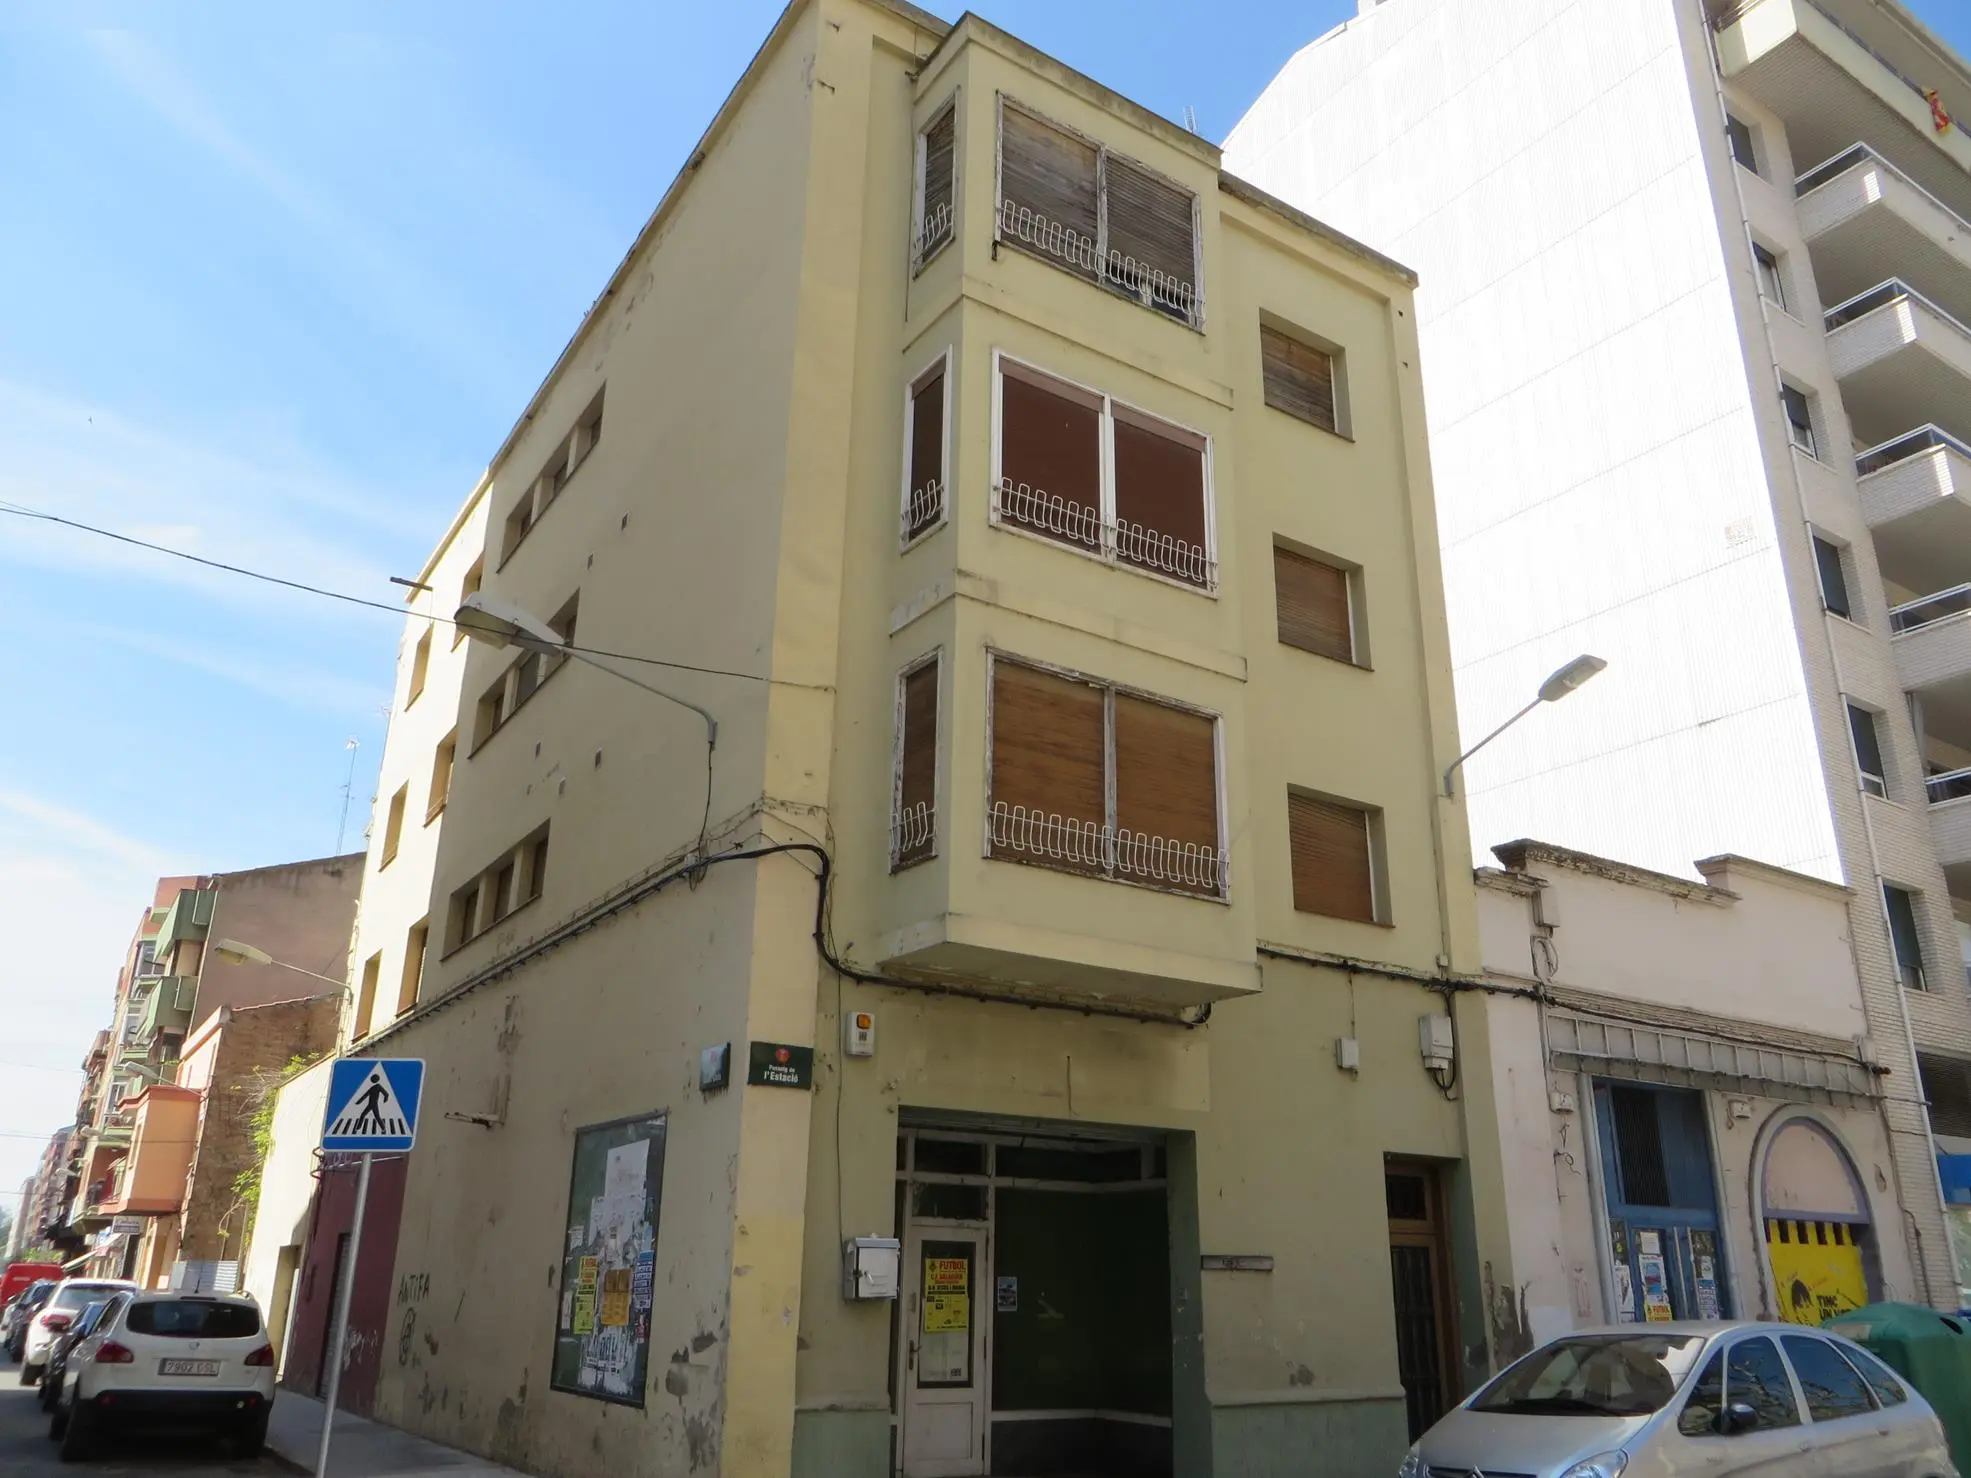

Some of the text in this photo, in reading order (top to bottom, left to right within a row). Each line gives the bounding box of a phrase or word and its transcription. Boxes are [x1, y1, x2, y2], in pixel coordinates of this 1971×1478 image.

[764, 1070, 799, 1082] l'Estació
[939, 1260, 966, 1270] FUTBOL
[397, 1272, 430, 1307] ANTIFA
